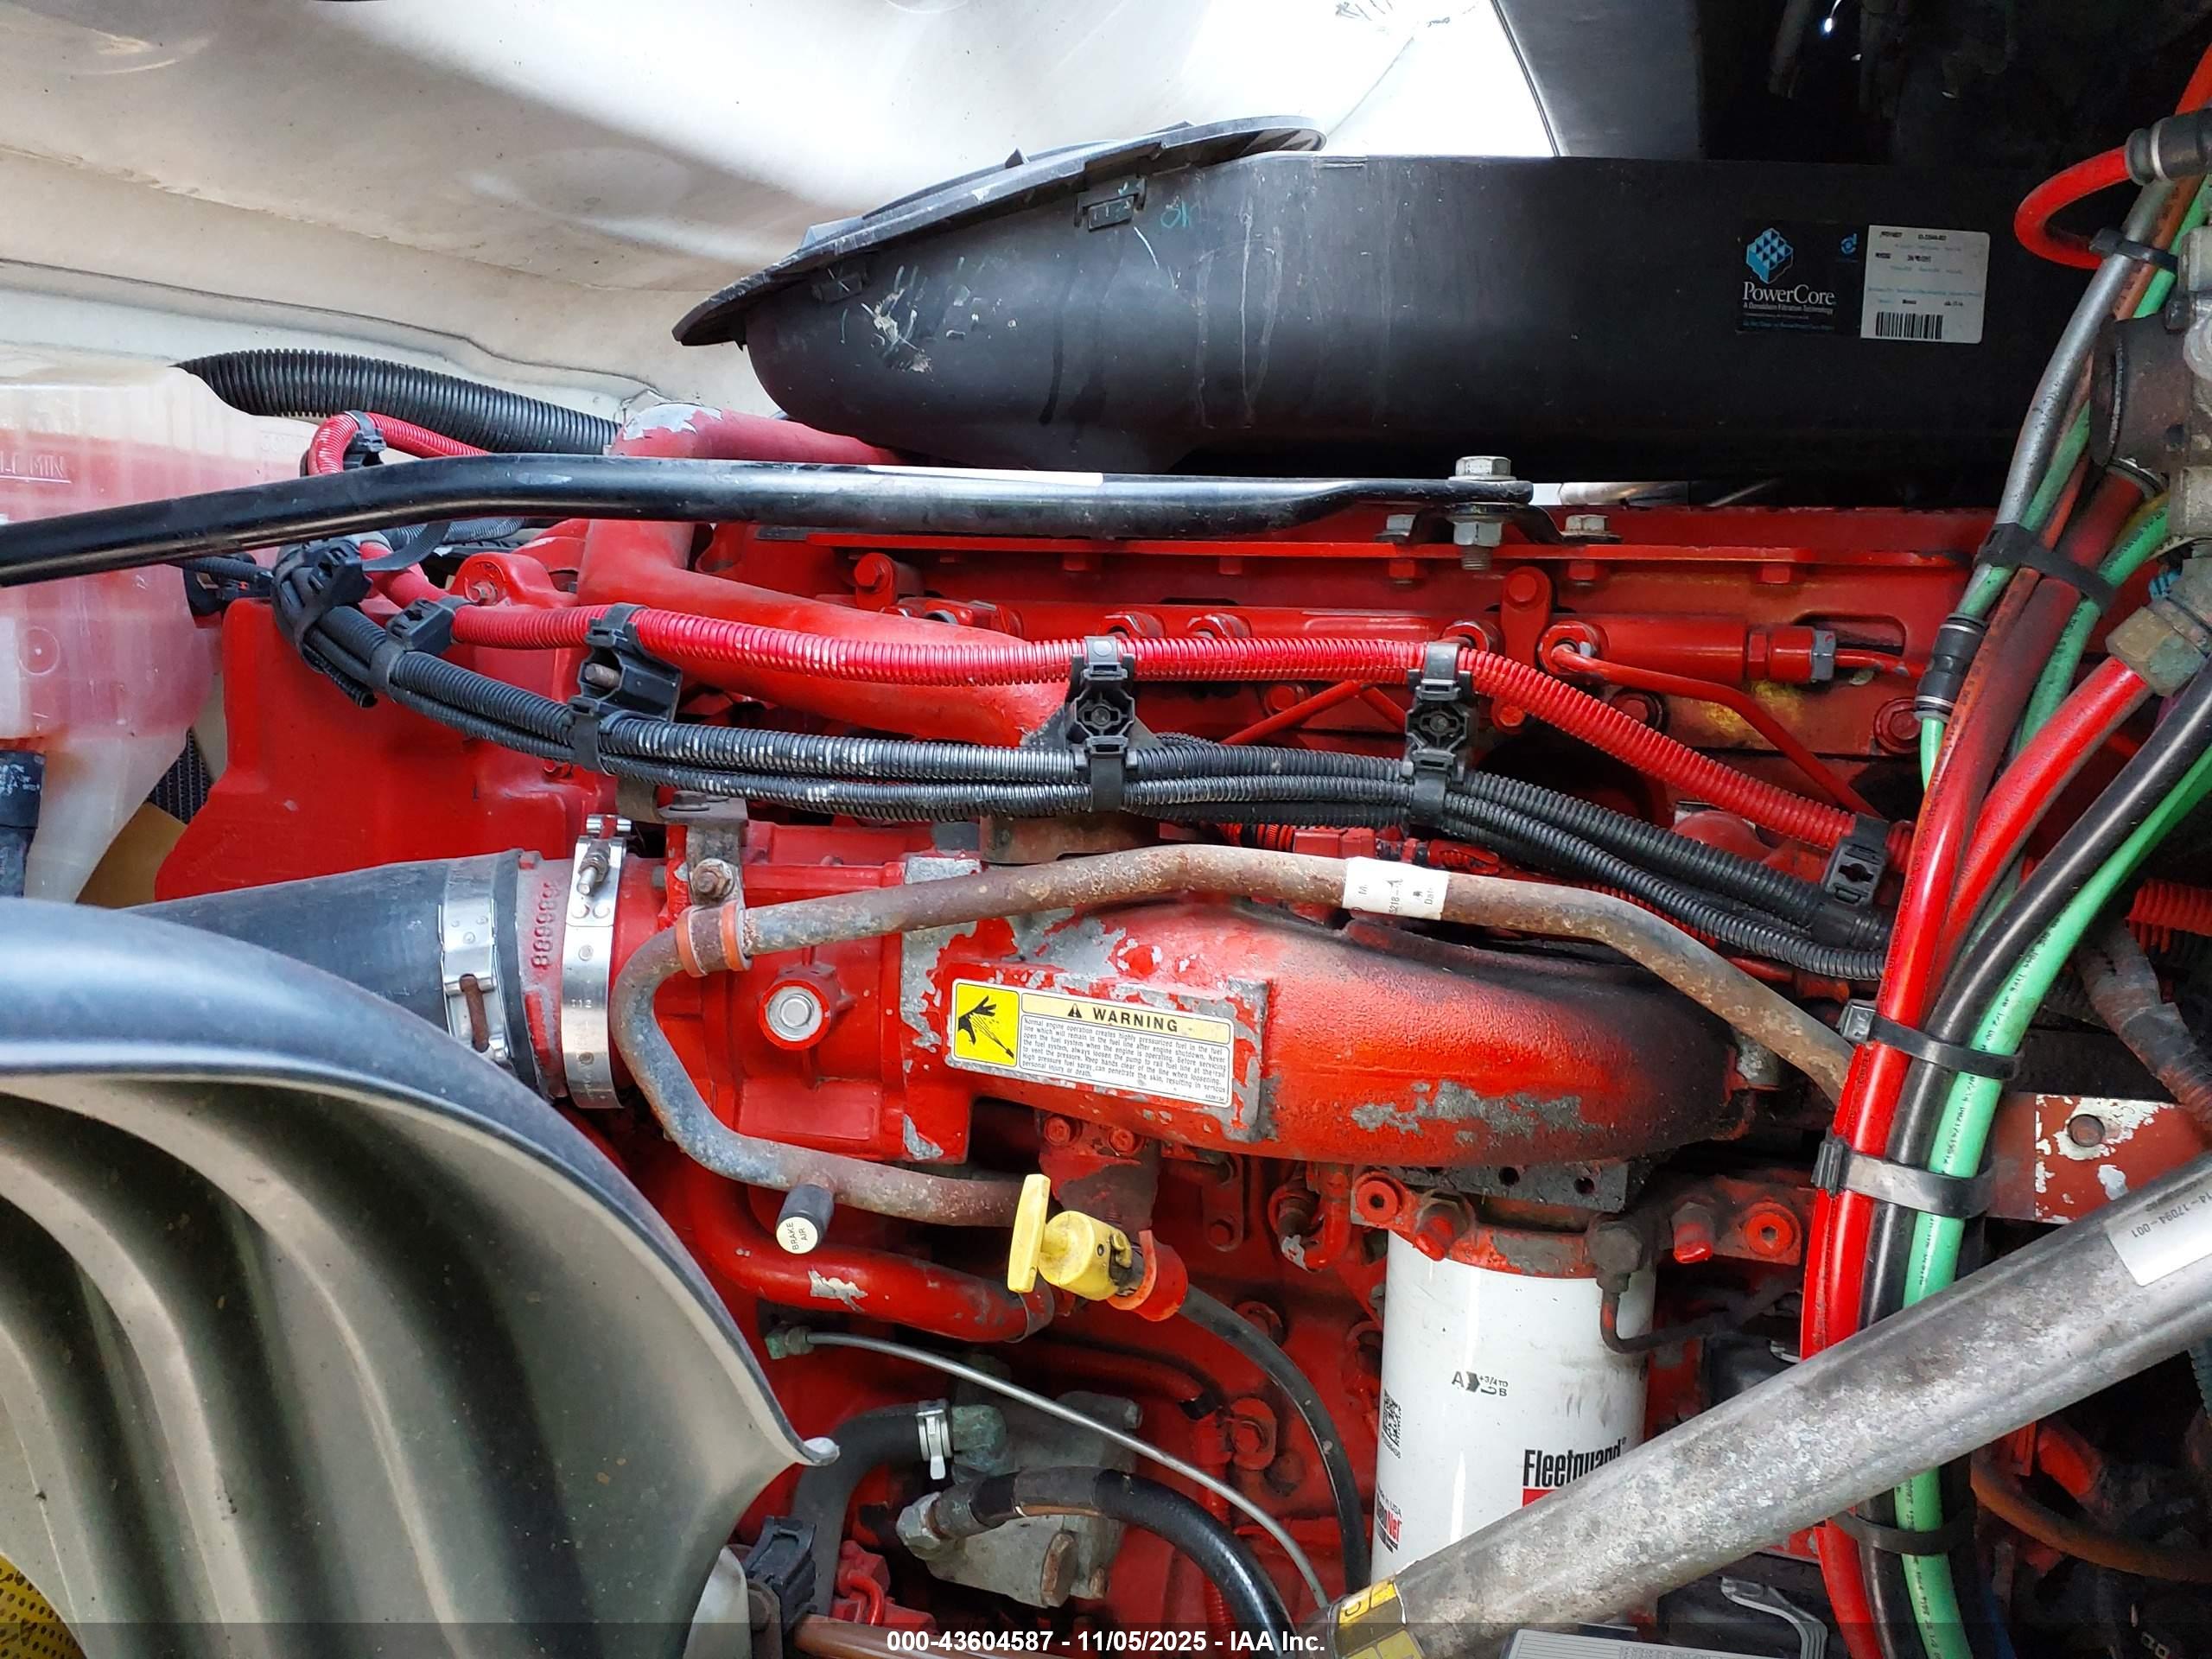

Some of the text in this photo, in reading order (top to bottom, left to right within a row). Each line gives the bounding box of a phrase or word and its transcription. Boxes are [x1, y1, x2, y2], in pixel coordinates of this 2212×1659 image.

[1742, 282, 1834, 305] PowerCore
[1093, 1007, 1178, 1032] WARNING
[1046, 1020, 1064, 1031] engine
[1066, 1024, 1092, 1035] operation
[1095, 1028, 1116, 1037] creates
[1118, 1032, 1135, 1042] highly
[1139, 1035, 1173, 1048] pressurized
[1064, 1038, 1083, 1048] system
[1115, 1046, 1134, 1056] engine
[1198, 1060, 1226, 1071] servicing
[1092, 1050, 1111, 1058] loosen
[1153, 1045, 1172, 1055] engine
[1022, 1059, 1046, 1070] personal
[1038, 1056, 1061, 1065] pressure
[1108, 1067, 1134, 1078] penetrate
[786, 1222, 799, 1250] BRAKE
[798, 1227, 808, 1241] AIR
[1451, 1370, 1465, 1389] A
[1499, 1388, 1508, 1396] B
